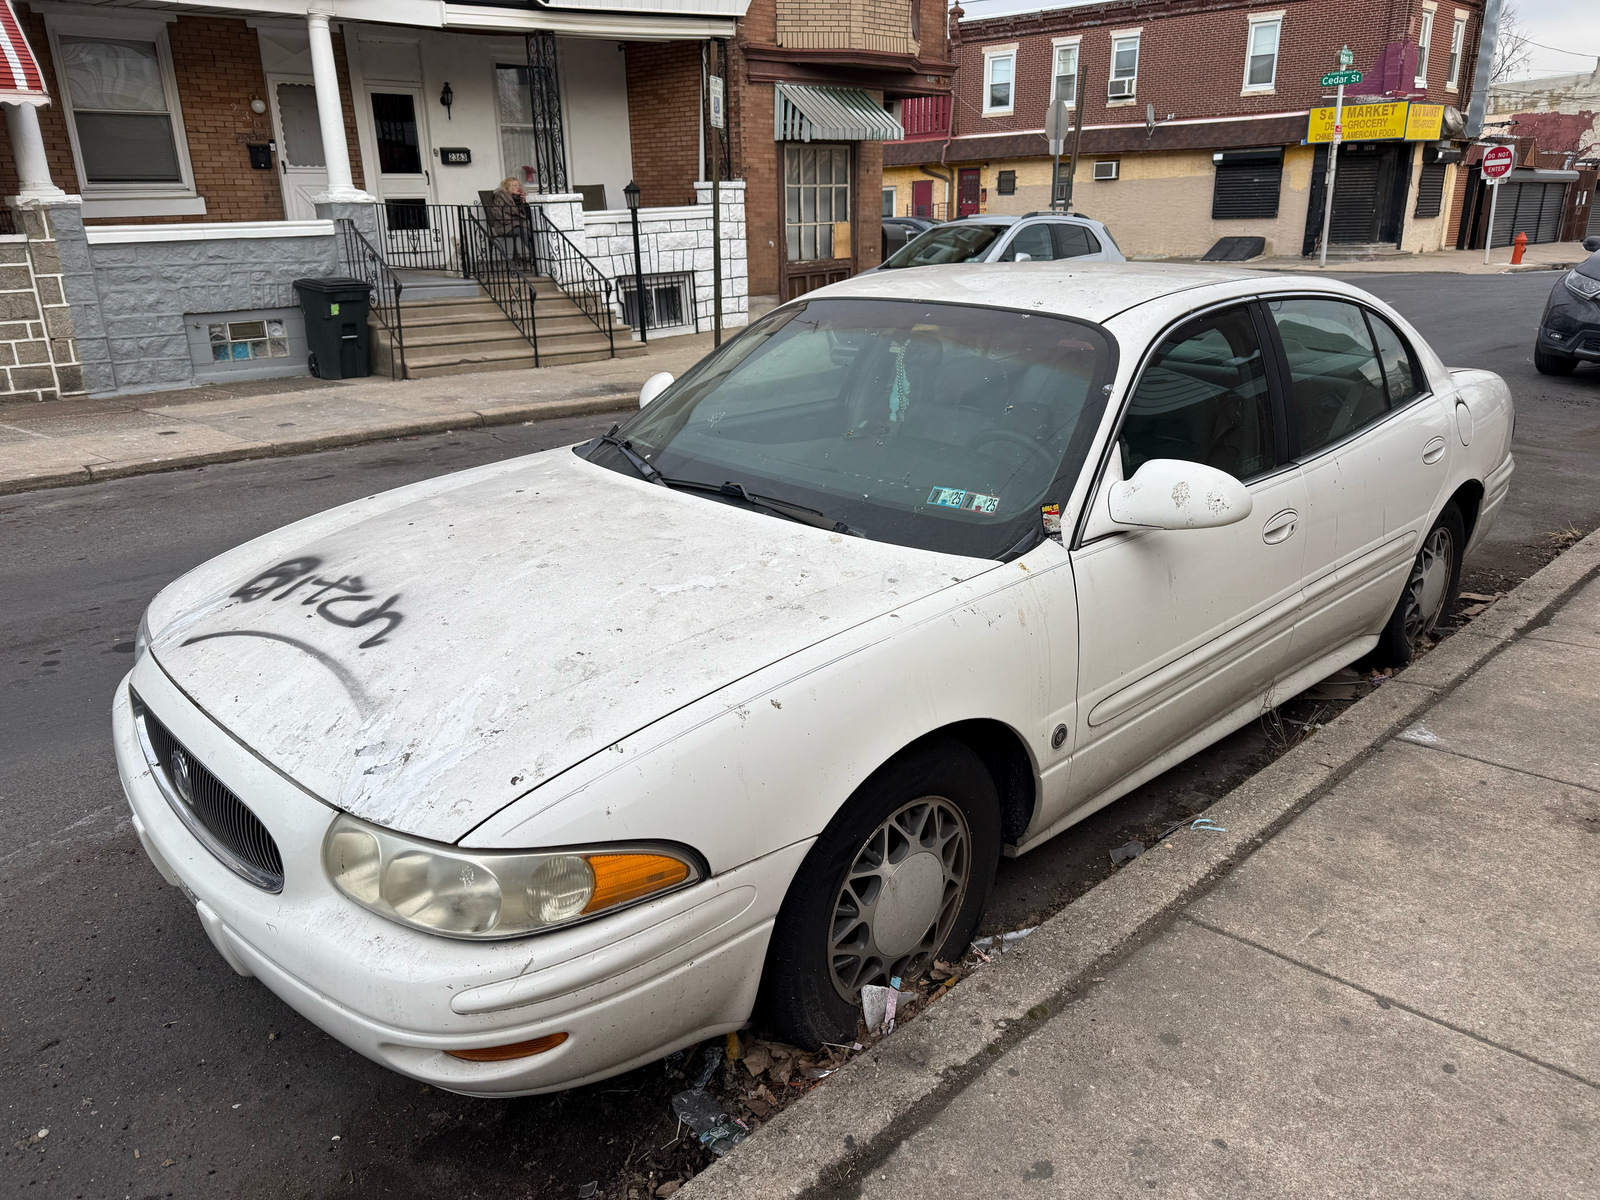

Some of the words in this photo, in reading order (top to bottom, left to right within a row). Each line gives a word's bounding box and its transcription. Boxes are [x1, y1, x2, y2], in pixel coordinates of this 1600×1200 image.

[1322, 76, 1348, 85] Cedar
[1351, 74, 1360, 82] St
[1319, 109, 1327, 120] S
[1327, 111, 1334, 120] &
[1347, 104, 1398, 119] MARKET
[1346, 130, 1377, 139] AMERICAN
[1378, 128, 1397, 137] FOOD
[951, 492, 964, 505] 25
[986, 498, 998, 512] 25
